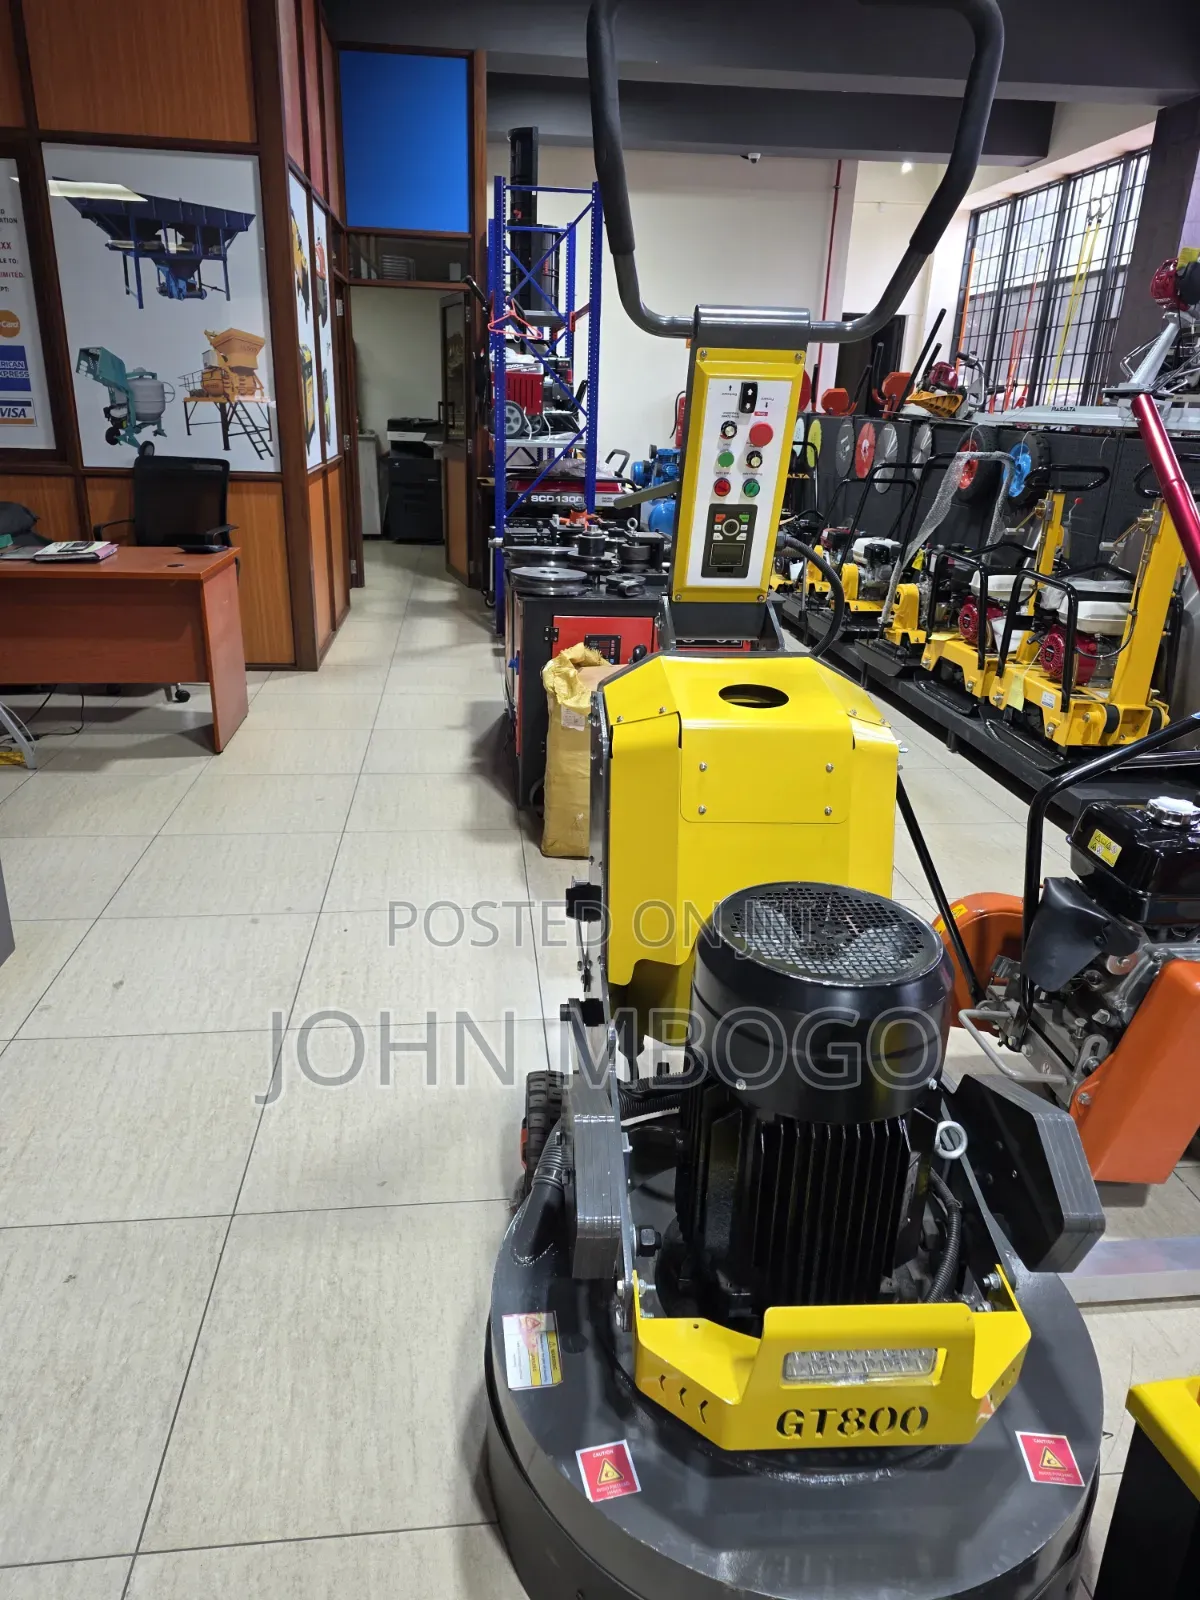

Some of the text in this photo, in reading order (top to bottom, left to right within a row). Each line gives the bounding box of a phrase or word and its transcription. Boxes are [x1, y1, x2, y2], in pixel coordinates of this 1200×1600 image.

[0, 407, 27, 418] VISA
[776, 1406, 929, 1440] GT800
[592, 1448, 614, 1458] CAUTION
